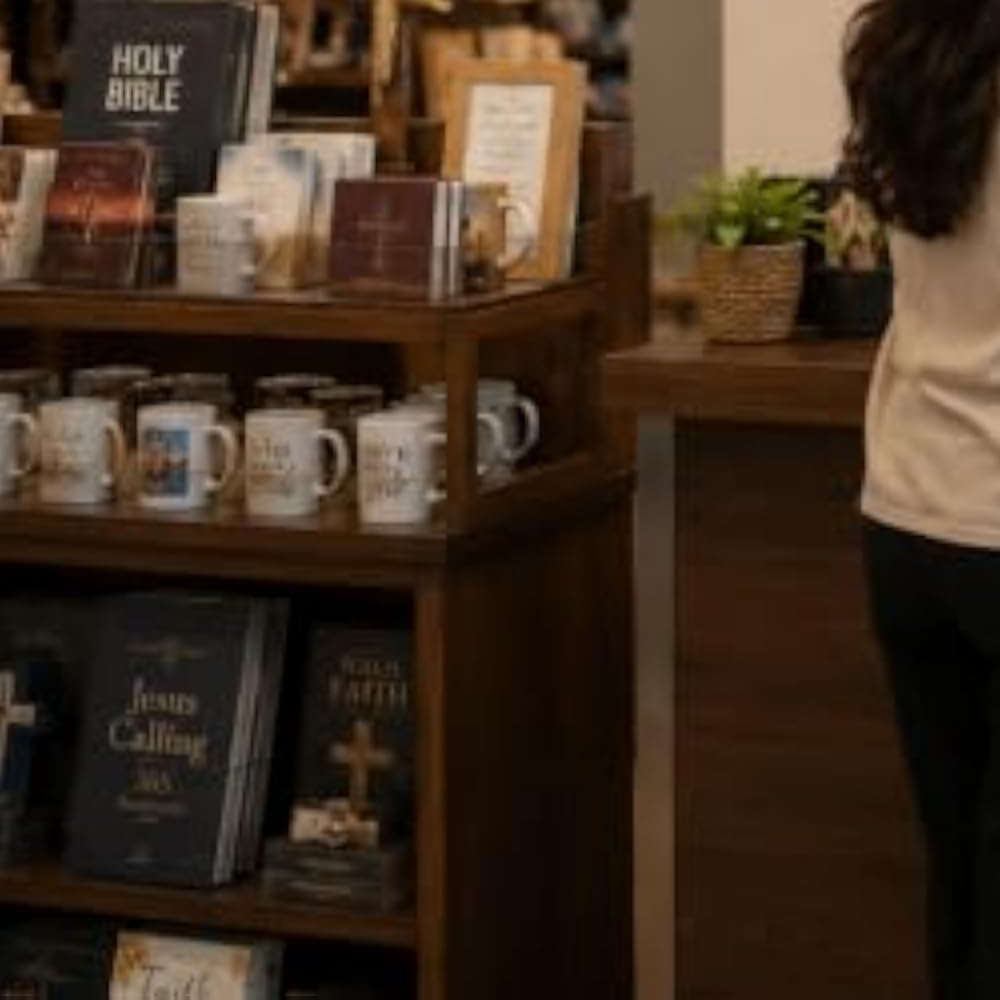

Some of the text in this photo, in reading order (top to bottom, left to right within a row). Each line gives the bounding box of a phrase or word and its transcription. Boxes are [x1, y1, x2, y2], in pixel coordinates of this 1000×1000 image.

[110, 43, 187, 78] HOLY
[105, 78, 181, 113] BIBLE
[126, 676, 200, 716] Jesus
[108, 717, 209, 768] Calling
